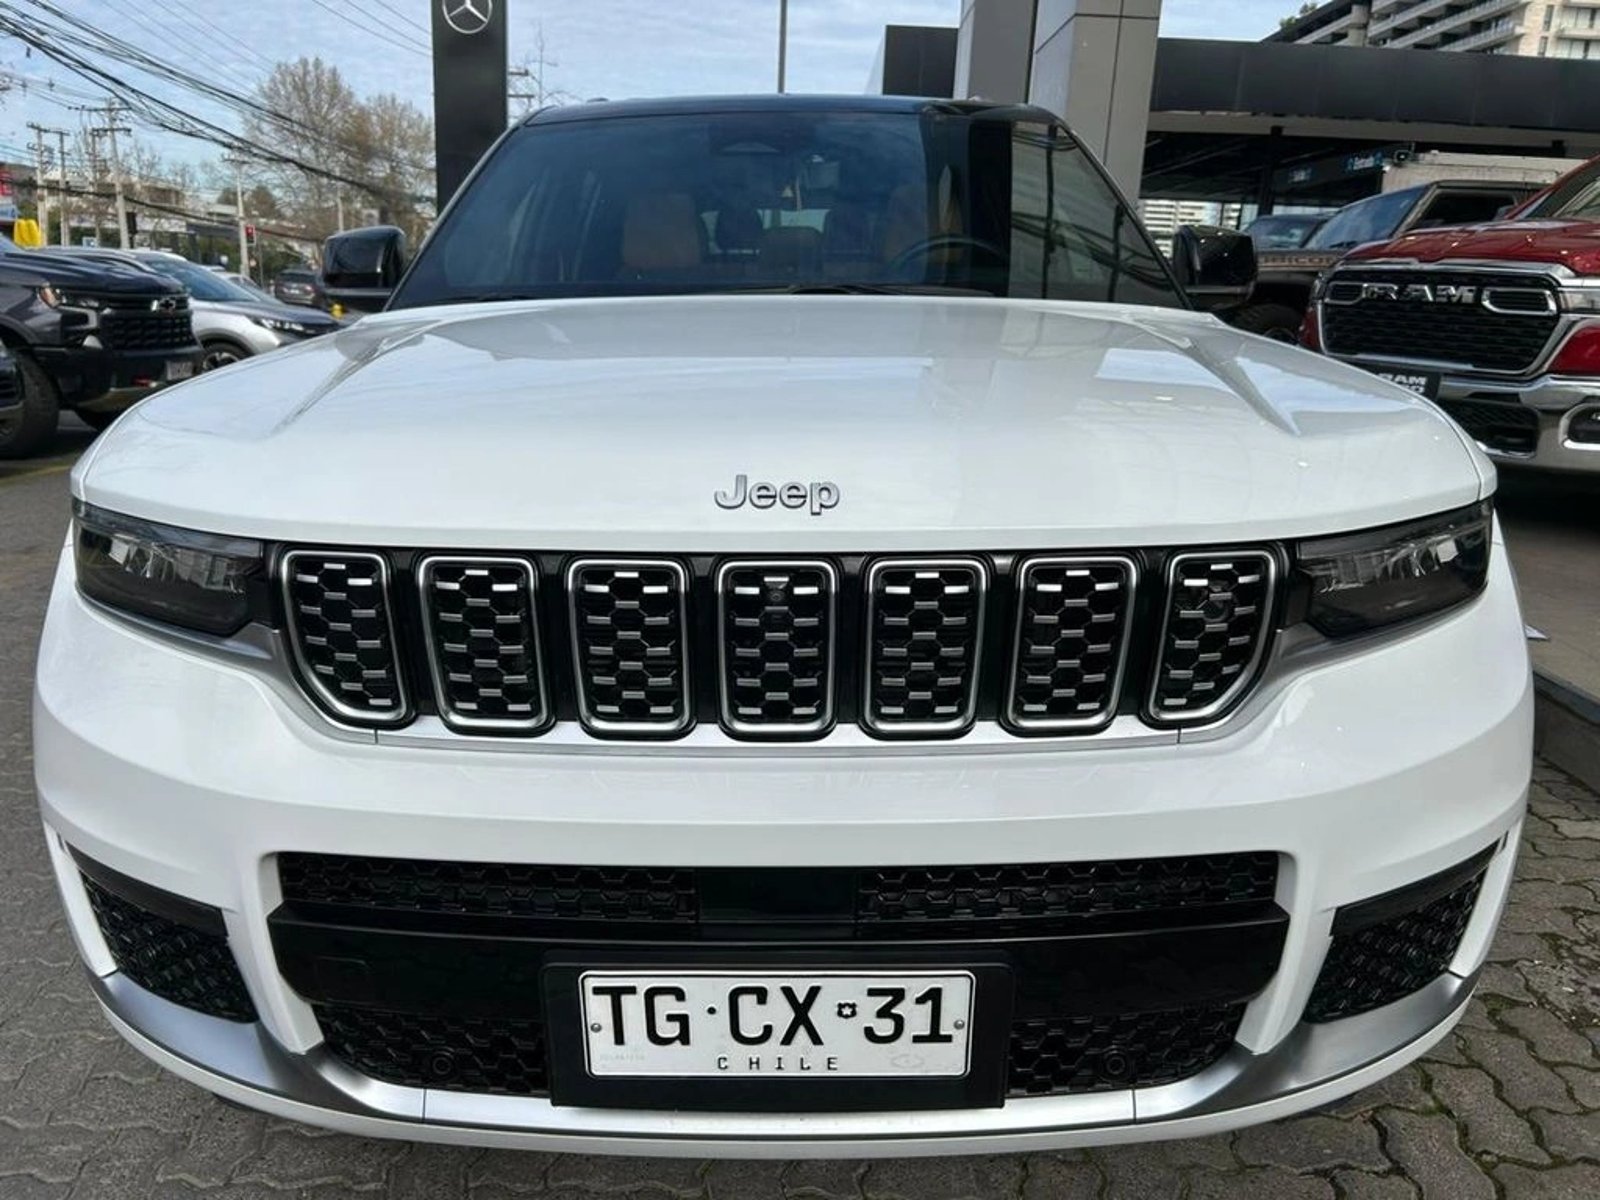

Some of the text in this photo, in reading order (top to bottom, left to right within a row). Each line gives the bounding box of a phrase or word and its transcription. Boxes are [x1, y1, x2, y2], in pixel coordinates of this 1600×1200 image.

[1362, 283, 1477, 303] RAM
[714, 474, 840, 516] Jeep
[863, 986, 953, 1044] 31
[716, 1056, 839, 1071] CHILE
